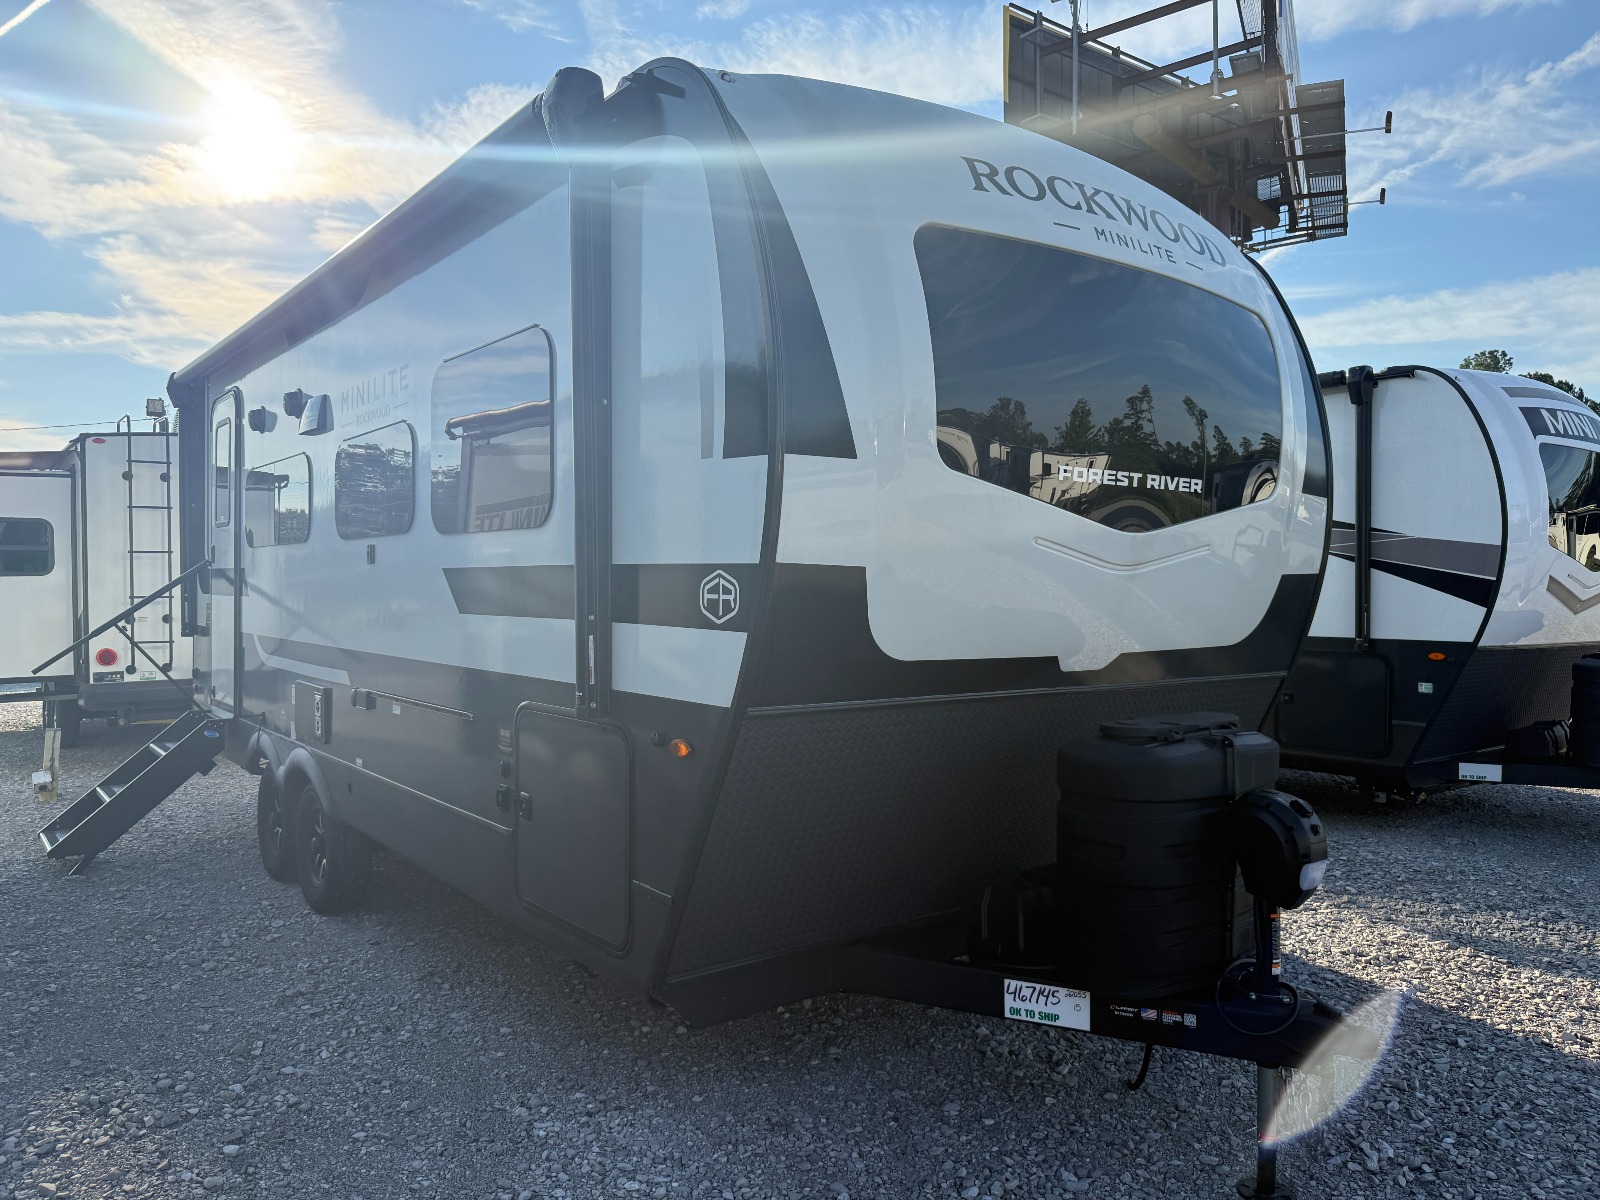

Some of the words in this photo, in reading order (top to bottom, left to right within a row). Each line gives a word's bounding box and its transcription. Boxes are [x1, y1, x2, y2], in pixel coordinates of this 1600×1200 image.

[960, 155, 1226, 267] ROCKWOOD
[1094, 226, 1176, 264] MINILITE
[341, 363, 409, 414] MINILITE
[1058, 464, 1143, 488] FOREST
[1146, 473, 1202, 493] RIVER
[1005, 981, 1061, 1007] 467145
[1009, 1006, 1022, 1017] OK
[1024, 1008, 1036, 1019] TO
[1037, 1010, 1060, 1023] SHIP
